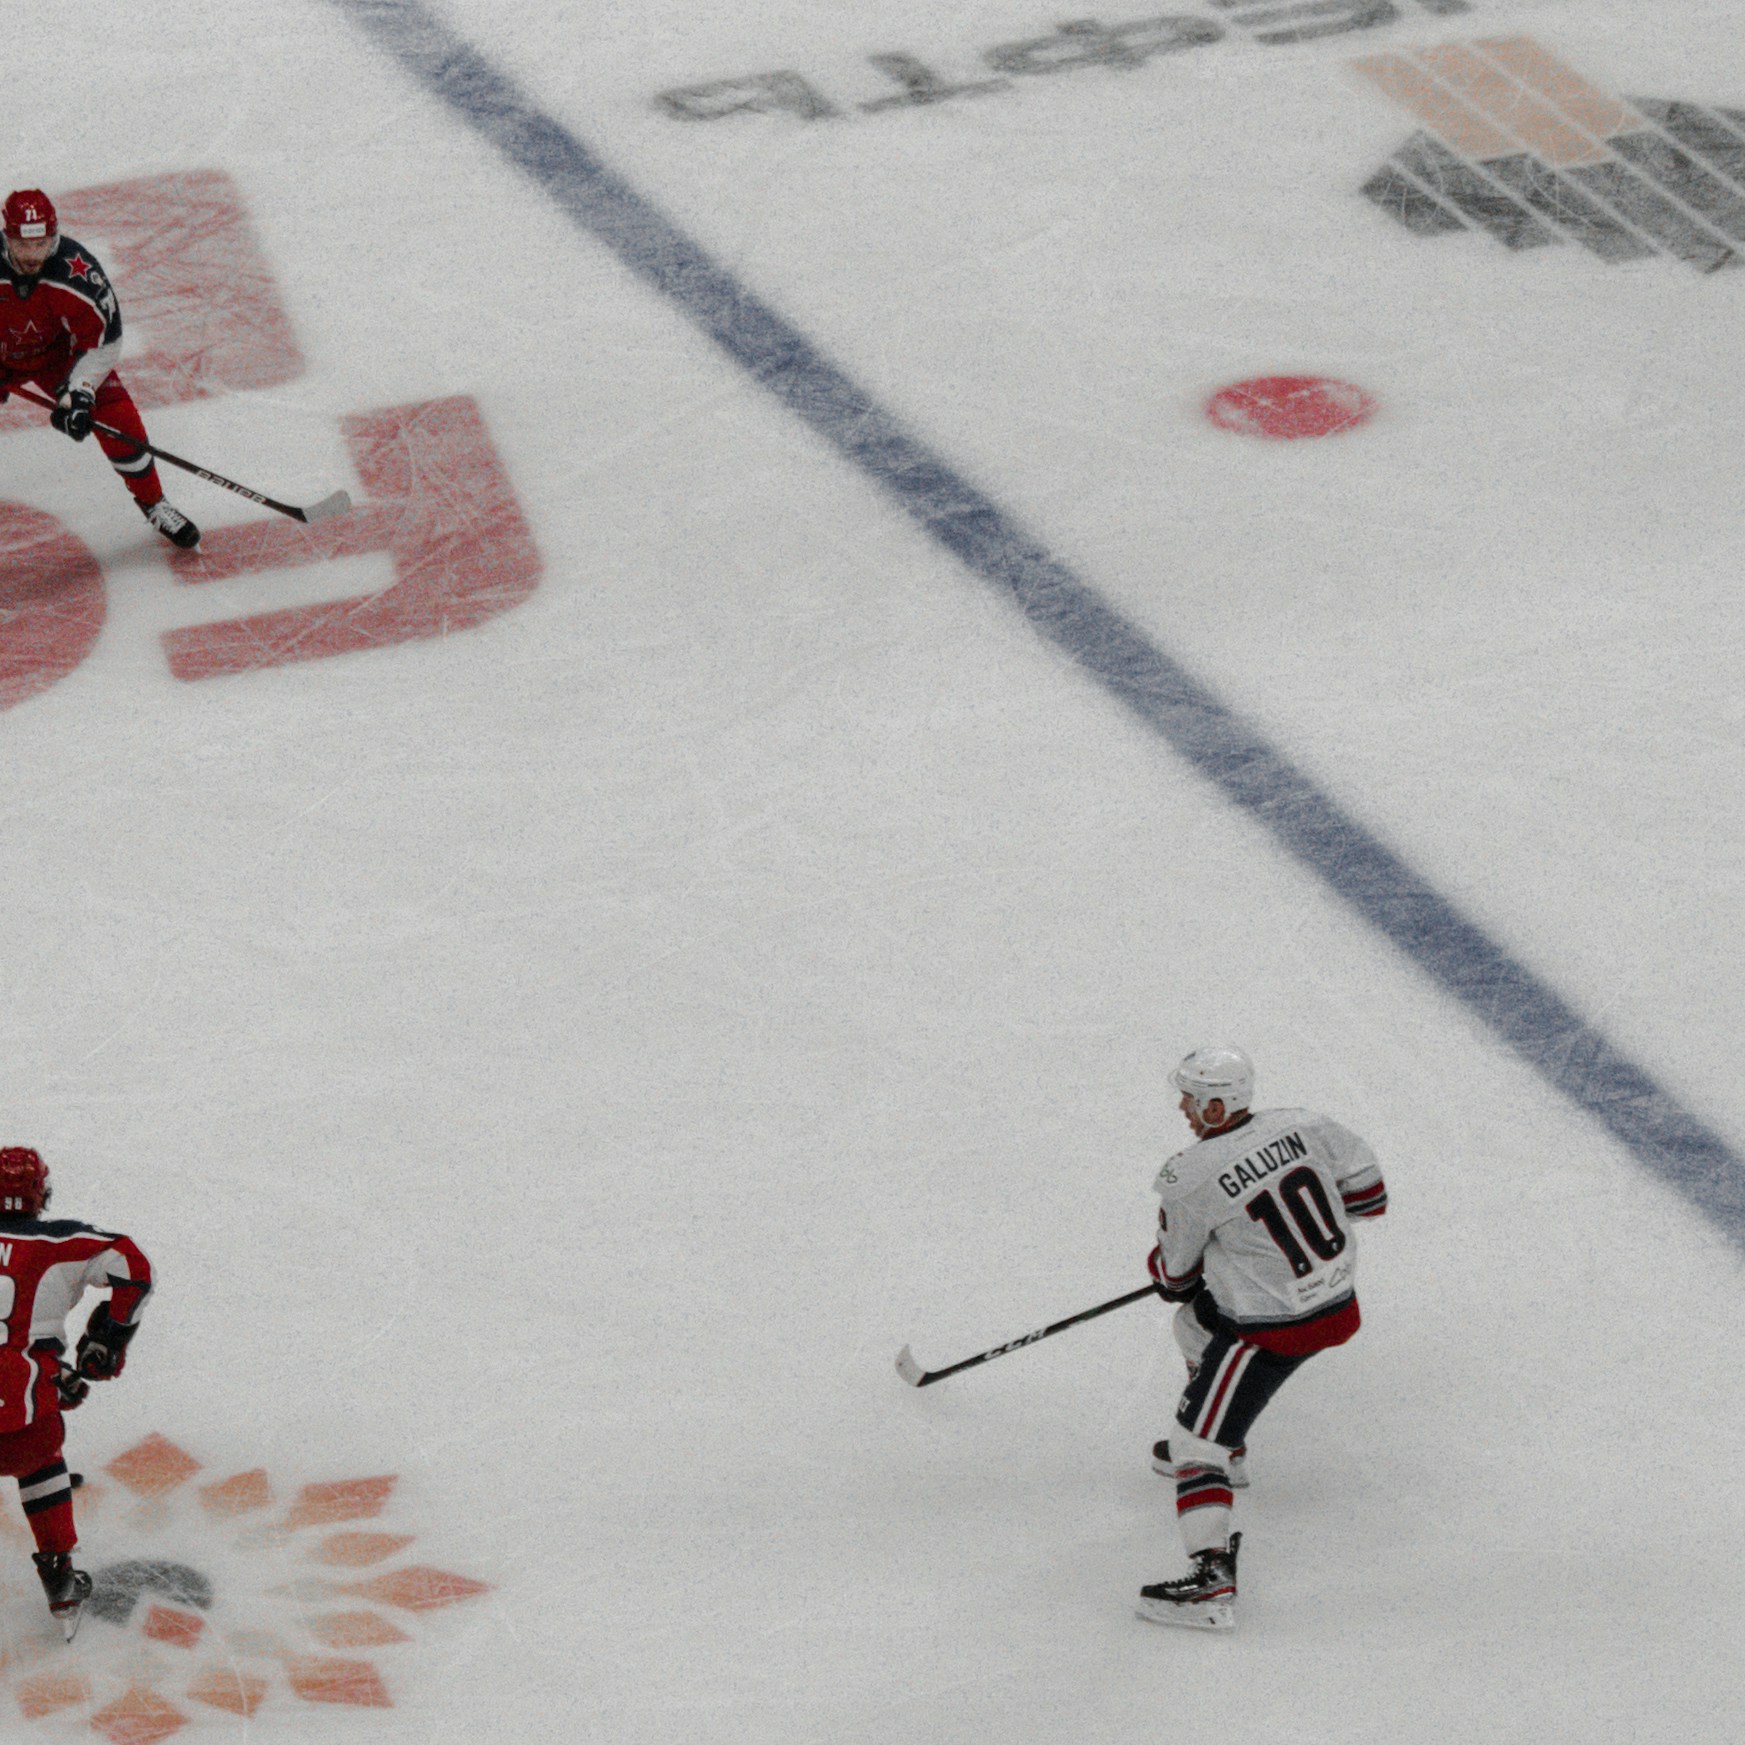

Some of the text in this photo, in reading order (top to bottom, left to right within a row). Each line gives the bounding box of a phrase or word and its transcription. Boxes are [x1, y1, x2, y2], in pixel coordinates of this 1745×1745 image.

[196, 468, 266, 503] BAUER
[1217, 1131, 1308, 1199] GALUZIN
[1245, 1166, 1346, 1279] 10
